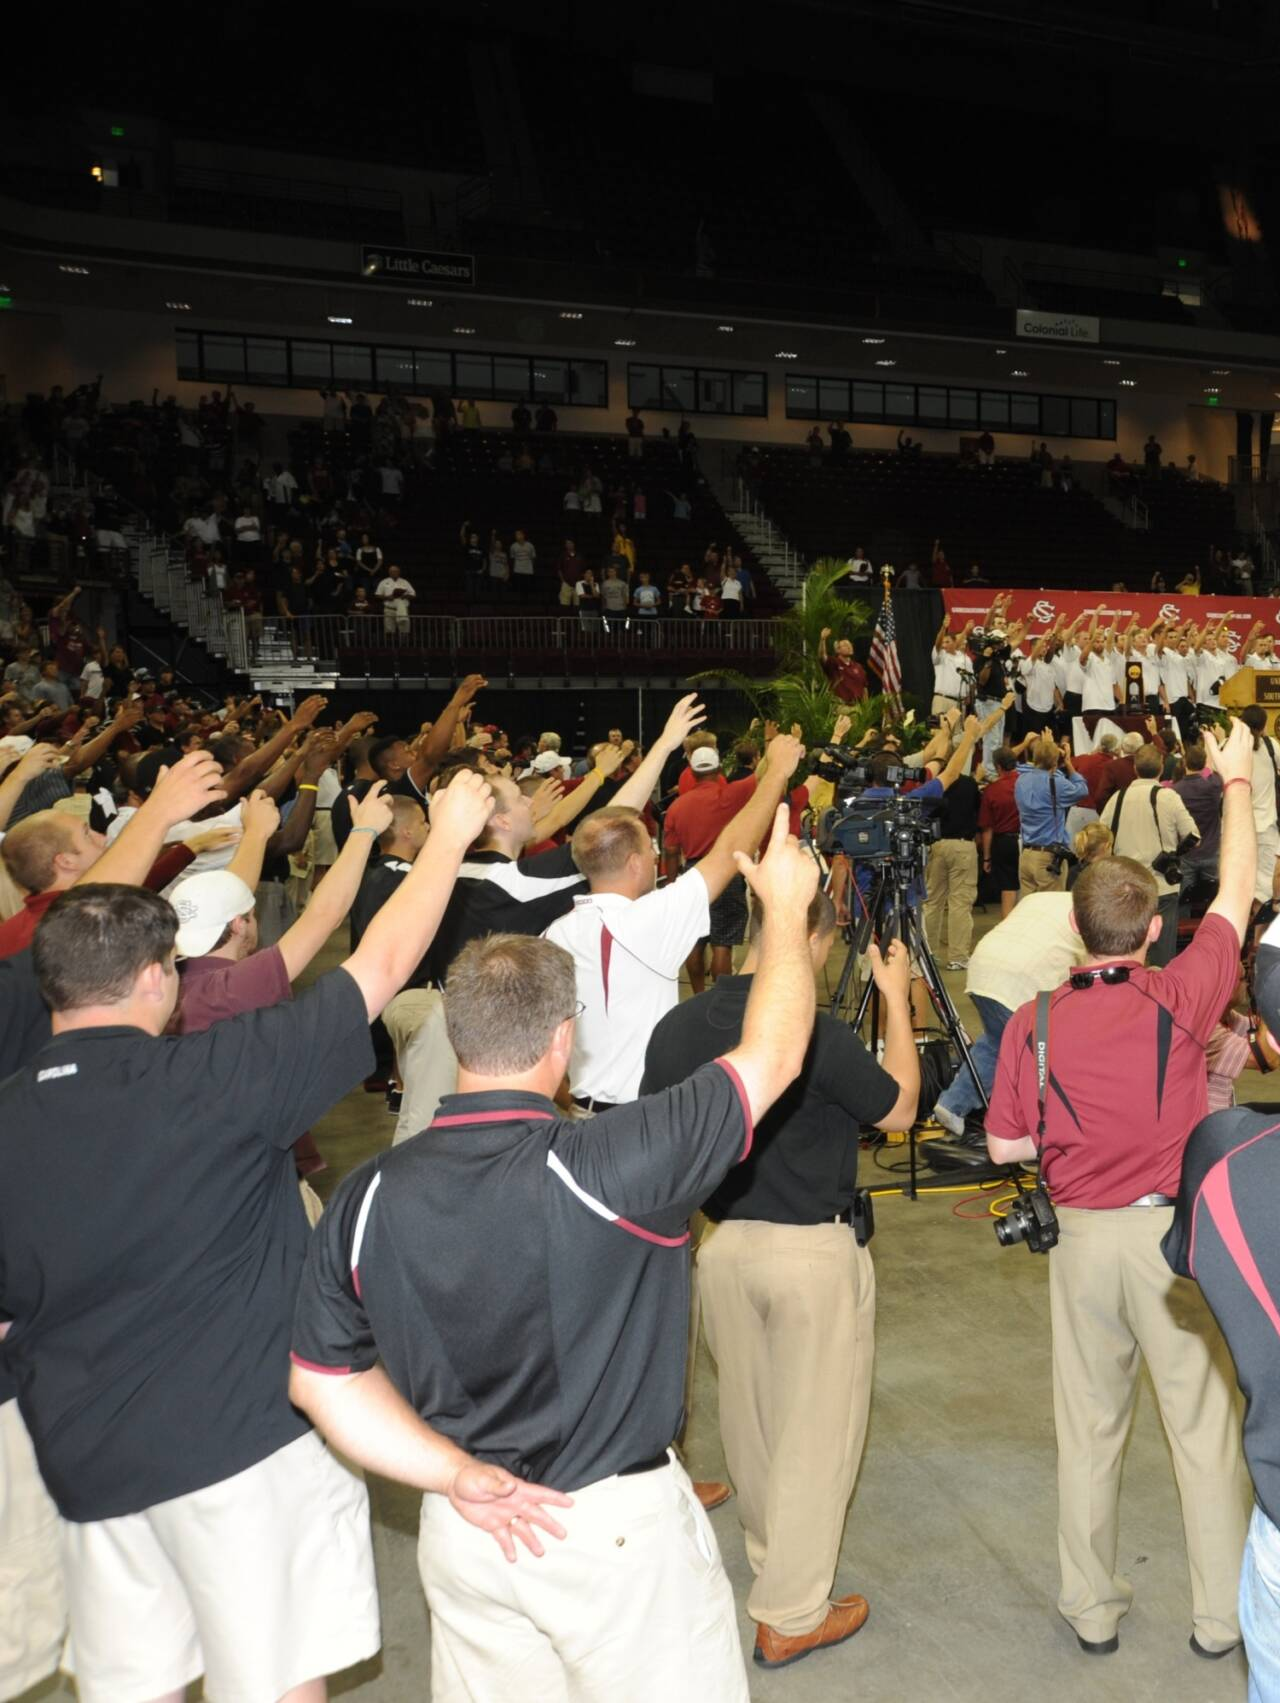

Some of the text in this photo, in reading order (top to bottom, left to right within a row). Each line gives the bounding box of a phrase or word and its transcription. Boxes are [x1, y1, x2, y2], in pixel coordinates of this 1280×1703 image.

[385, 256, 471, 278] Little Caesars
[1023, 322, 1068, 336] Colonial
[1037, 1041, 1046, 1088] DIGITAL
